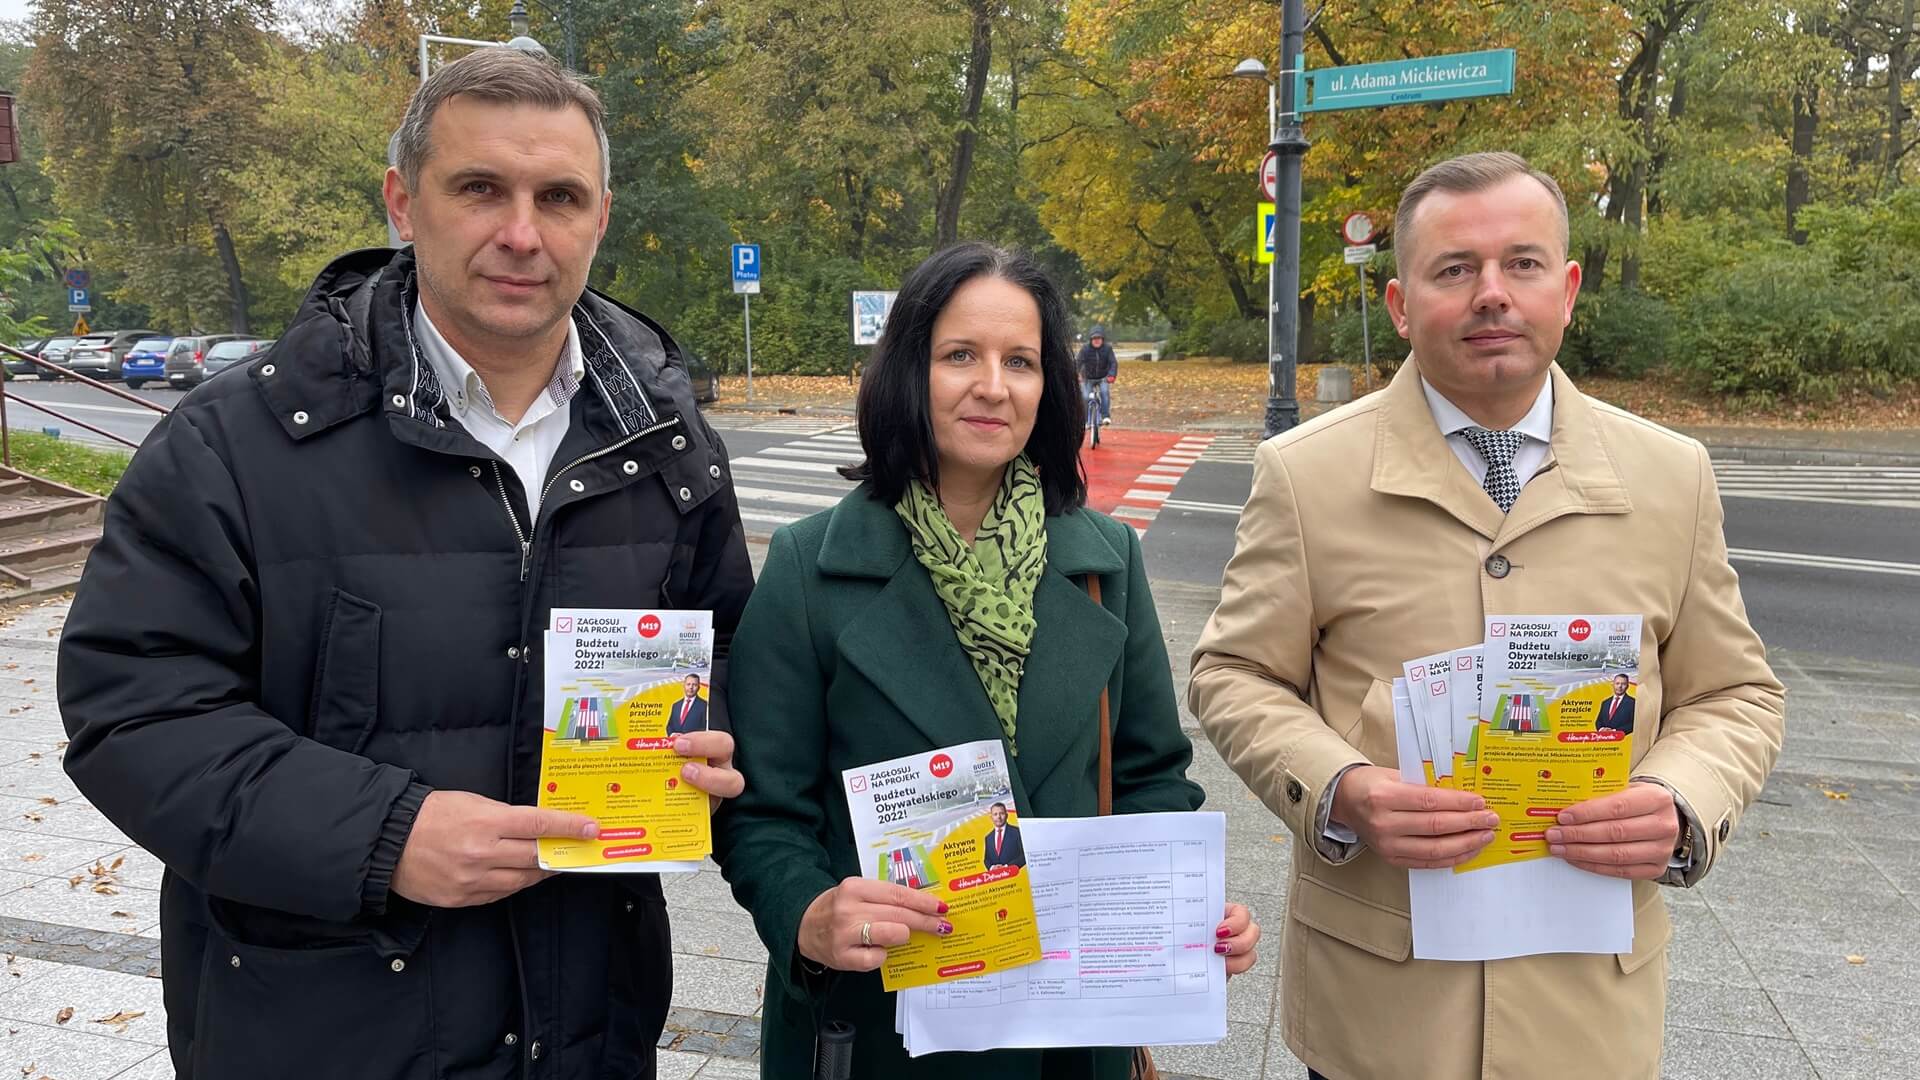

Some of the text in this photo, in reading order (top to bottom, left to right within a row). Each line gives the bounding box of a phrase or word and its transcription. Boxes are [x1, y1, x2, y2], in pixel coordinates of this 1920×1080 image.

[1331, 63, 1487, 91] ul. Adama Mickiewicza
[1391, 92, 1422, 101] Centrum
[739, 248, 754, 270] P
[74, 290, 84, 303] P
[576, 618, 620, 626] ZAGŁOSUJ
[1509, 623, 1551, 631] ZAGŁOSUJ
[577, 626, 628, 634] NA PROJEKT
[1510, 630, 1558, 638] NA PROJEKT
[1571, 626, 1588, 634] M19
[576, 638, 619, 648] Budżetu
[1509, 641, 1550, 651] Budżetu
[575, 650, 659, 660] Obywatelskiego
[1508, 651, 1589, 662] Obywatelskiego
[574, 660, 605, 670] 2022!
[1507, 661, 1537, 670] 2022!
[630, 702, 663, 710] Aktywne
[1560, 706, 1592, 714] przejście
[629, 709, 662, 718] przejście
[932, 761, 950, 772] M19
[869, 765, 912, 781] ZAGŁOSUJ
[871, 771, 921, 789] NA PROJEKT
[873, 787, 917, 803] Budżetu
[875, 788, 959, 814] Obywatelskiego
[878, 811, 908, 825] 2022!
[943, 838, 976, 851] Aktywne
[944, 845, 977, 860] przejście
